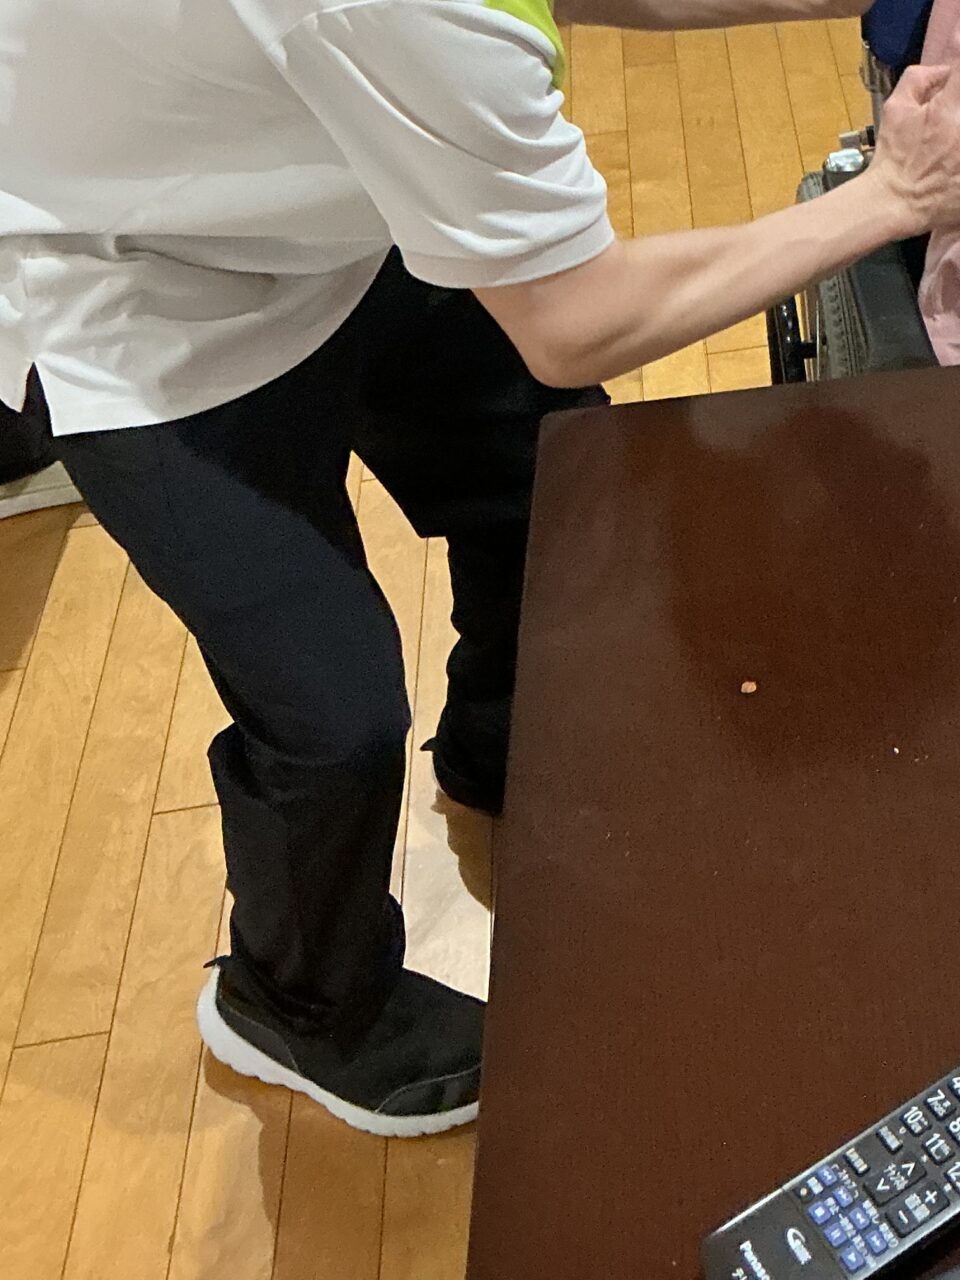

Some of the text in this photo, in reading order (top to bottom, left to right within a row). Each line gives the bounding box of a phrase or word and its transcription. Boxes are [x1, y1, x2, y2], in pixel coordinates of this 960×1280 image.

[927, 1089, 945, 1106] 7
[904, 1106, 923, 1124] 10
[926, 1133, 945, 1152] 11
